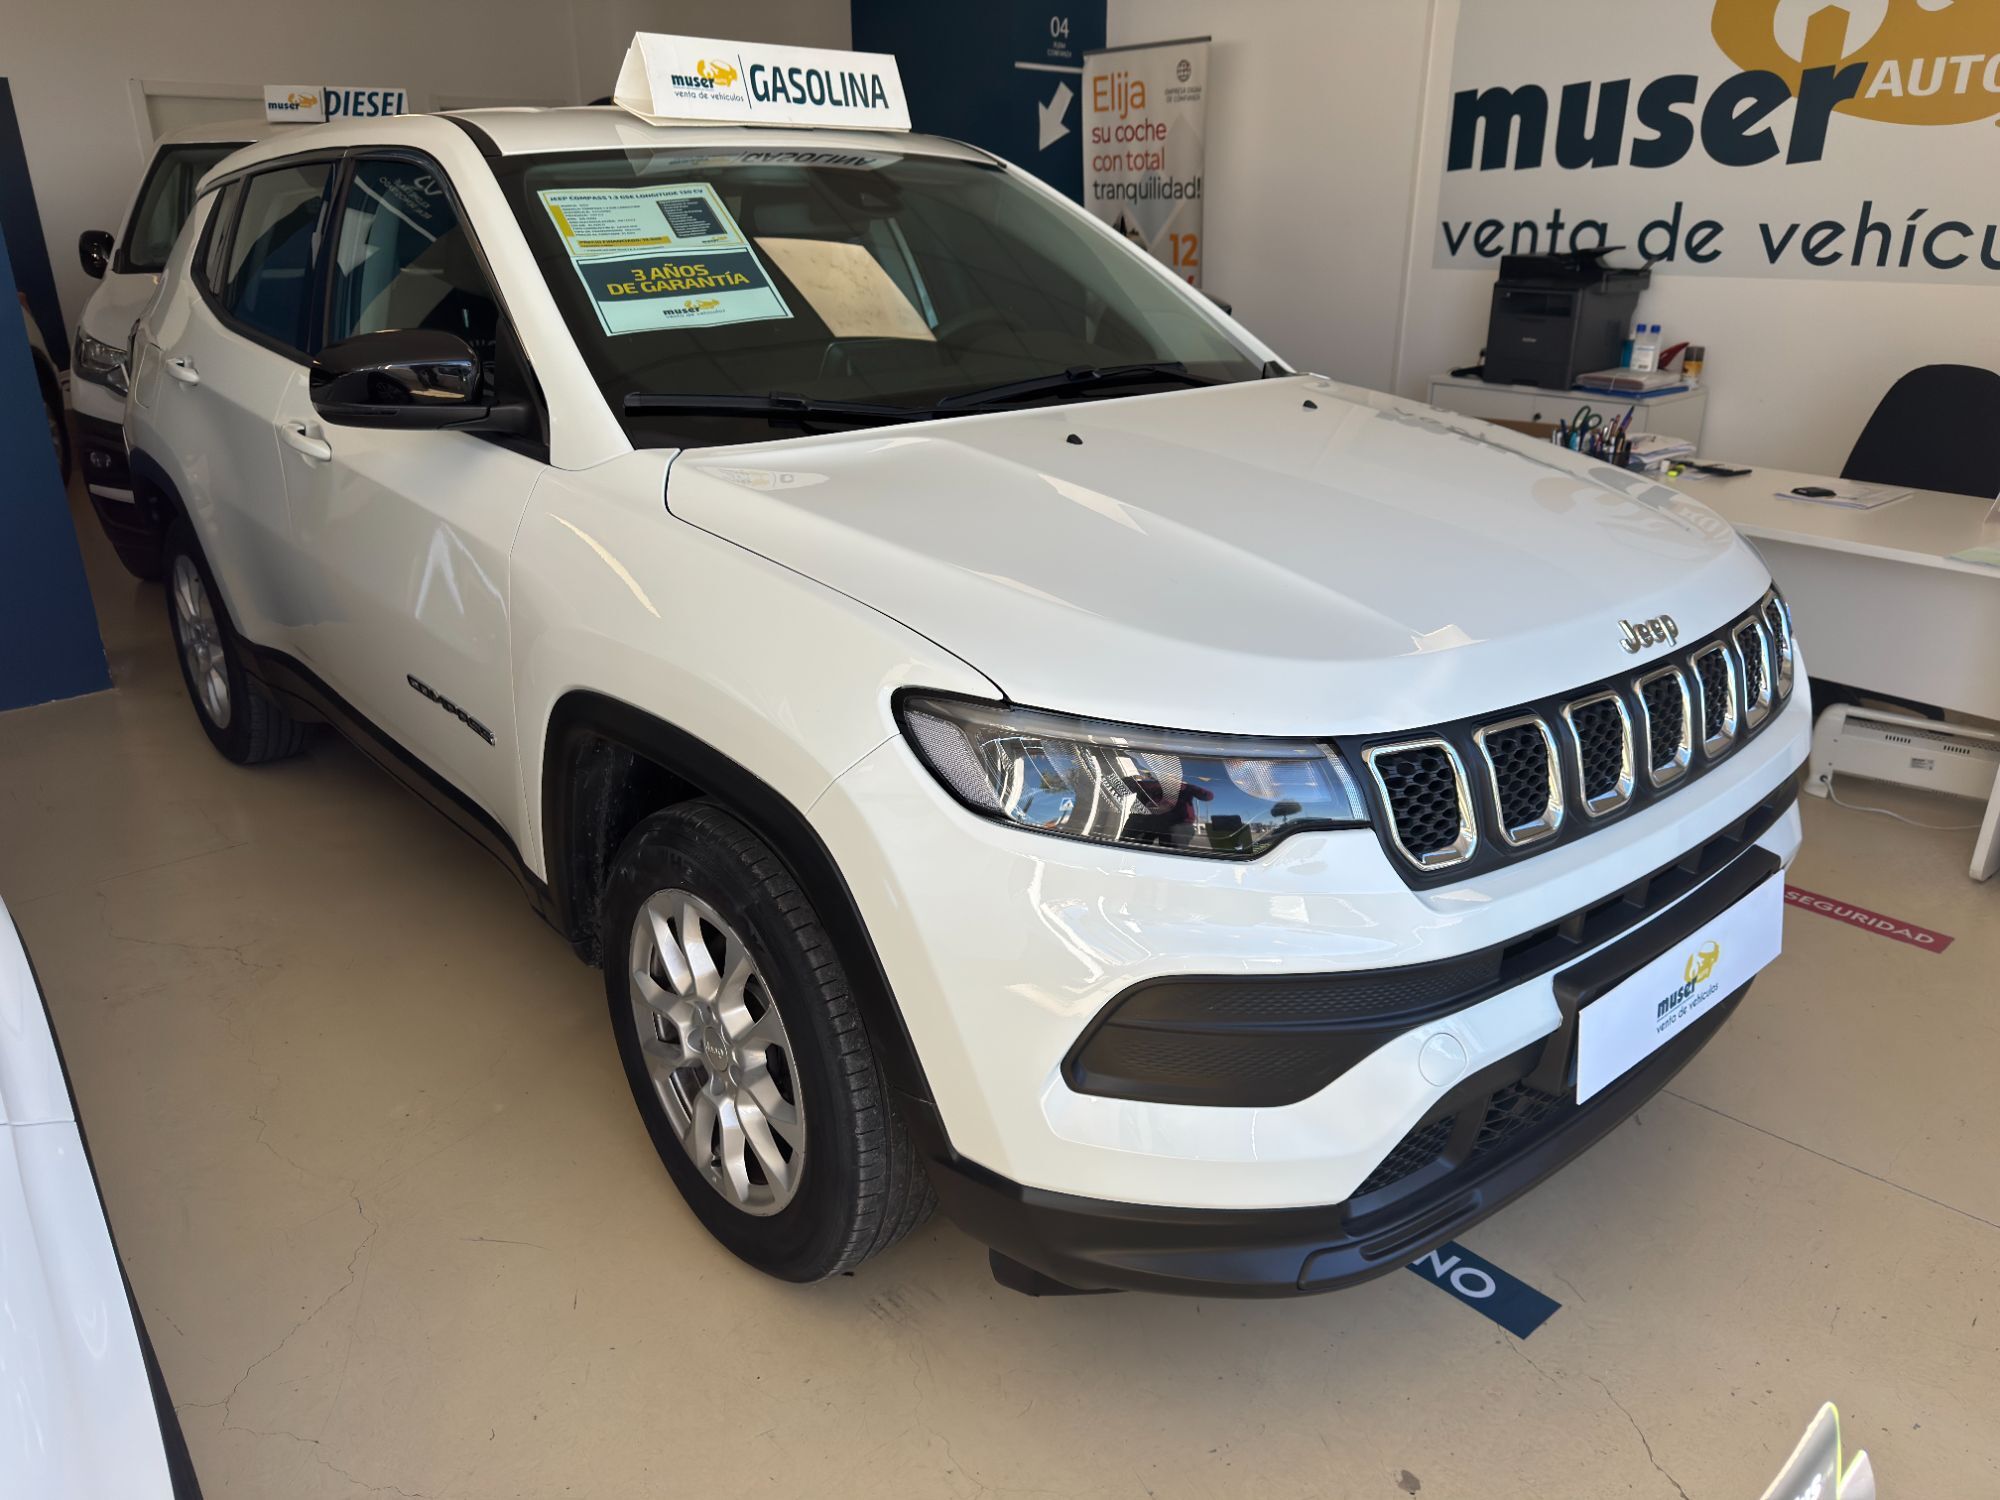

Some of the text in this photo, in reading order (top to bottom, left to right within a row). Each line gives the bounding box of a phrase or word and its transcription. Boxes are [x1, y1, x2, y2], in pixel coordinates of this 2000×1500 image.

[1050, 15, 1070, 39] 04
[671, 74, 715, 89] muser
[674, 90, 697, 99] venta
[698, 90, 709, 100] de
[749, 63, 890, 109] GASOLINA
[1092, 71, 1146, 120] Elija
[268, 101, 300, 110] muser
[326, 90, 404, 117] DIESEL
[1447, 61, 1869, 172] muser
[1092, 118, 1167, 144] su coche
[1092, 147, 1165, 172] con total
[1093, 176, 1202, 205] tranquilidad!
[1441, 208, 1608, 259] venta
[1636, 201, 1725, 264] de
[1169, 232, 1199, 268] 12
[606, 271, 751, 296] DE GARANTÍA
[631, 263, 709, 282] 3 AÑOS
[662, 307, 700, 316] muser
[1617, 614, 1679, 655] Jeep
[1785, 890, 1936, 945] SEGURIDAD
[1657, 975, 1698, 1019] muser
[1656, 1014, 1677, 1034] venta
[1677, 1004, 1688, 1019] de
